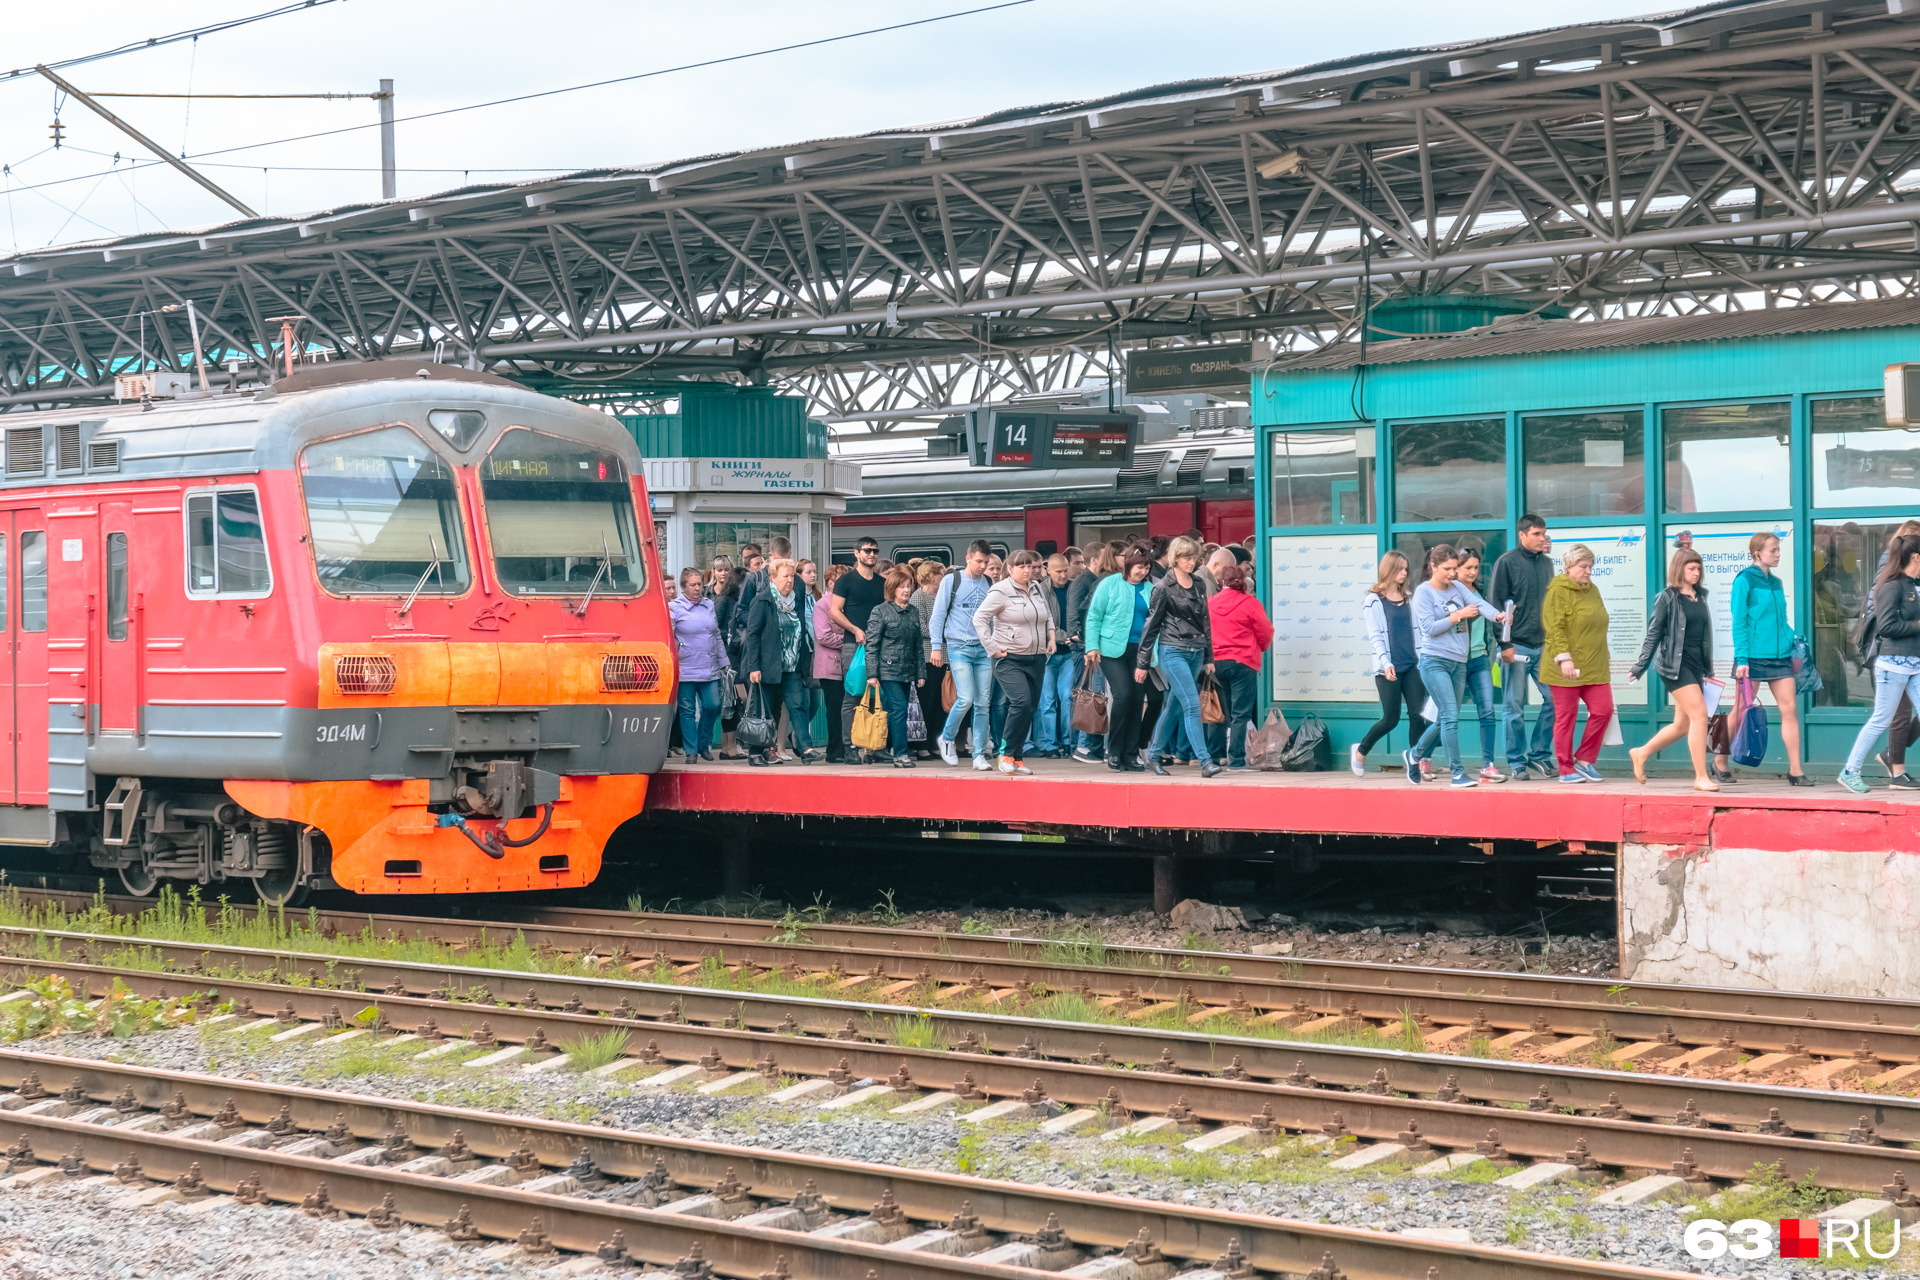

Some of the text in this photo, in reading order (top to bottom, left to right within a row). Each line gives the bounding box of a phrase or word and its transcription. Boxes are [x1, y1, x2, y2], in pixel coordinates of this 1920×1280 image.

[1148, 360, 1231, 377] КИНЕЛЬ СЫЗРАНЬ
[1005, 424, 1028, 446] 14
[711, 461, 762, 469] КНИГИ
[731, 470, 792, 478] ЖУРНАЛЫ
[764, 480, 814, 488] ГАЗЕТЫ
[1603, 555, 1628, 565] БИЛЕТ
[1701, 550, 1746, 562] ЕМЕНТНЫЙ
[622, 717, 662, 733] 1017
[316, 724, 366, 742] ЭД4М
